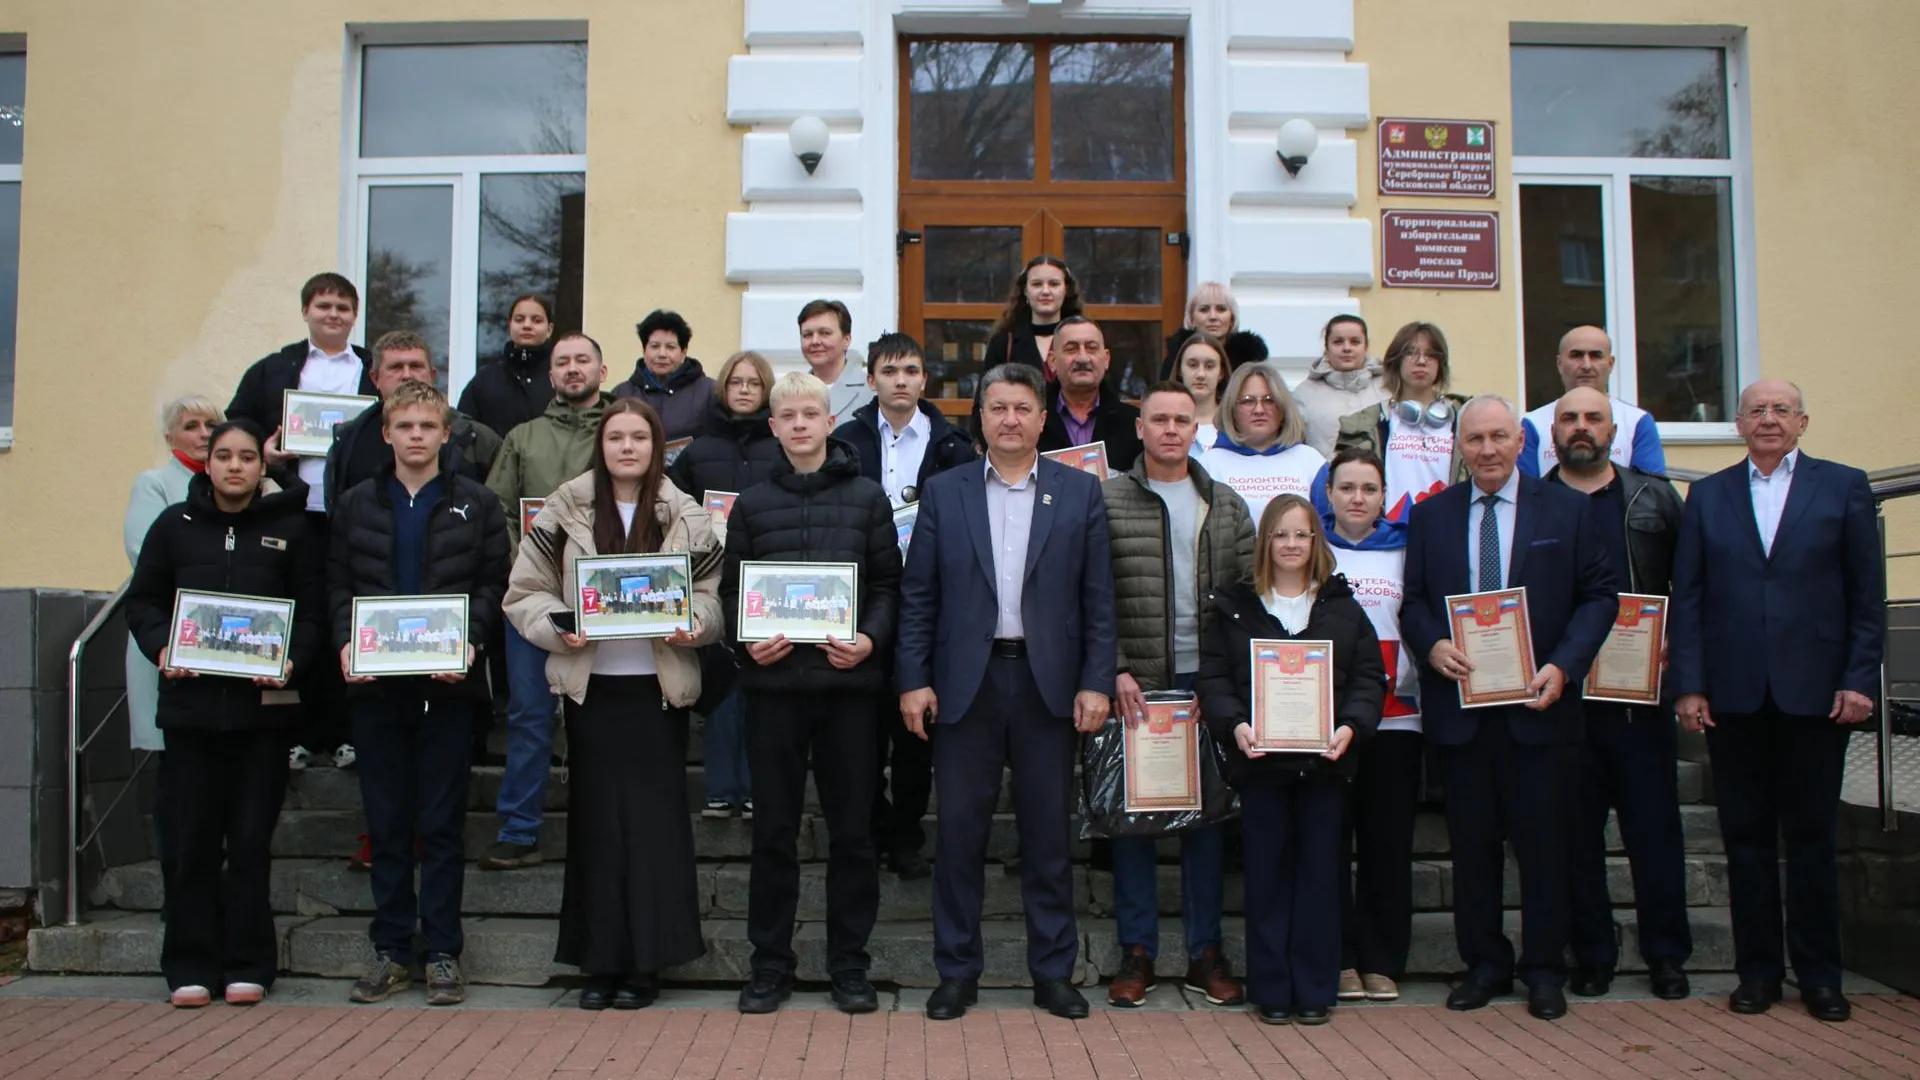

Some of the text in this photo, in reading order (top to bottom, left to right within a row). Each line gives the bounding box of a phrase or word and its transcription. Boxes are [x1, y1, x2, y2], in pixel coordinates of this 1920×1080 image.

[1383, 147, 1491, 162] Администрация
[1383, 162, 1491, 172] муниципального округа
[1387, 168, 1487, 181] Серебряные Пруды
[1385, 179, 1490, 190] Московской области
[1392, 216, 1489, 229] Территориальная
[1400, 229, 1481, 241] избирательная
[1415, 245, 1467, 253] комиссии
[1419, 257, 1463, 266] поселка
[1388, 268, 1494, 281] Серебряные Пруды
[1231, 484, 1308, 492] ОДМОСКОВЬЯ
